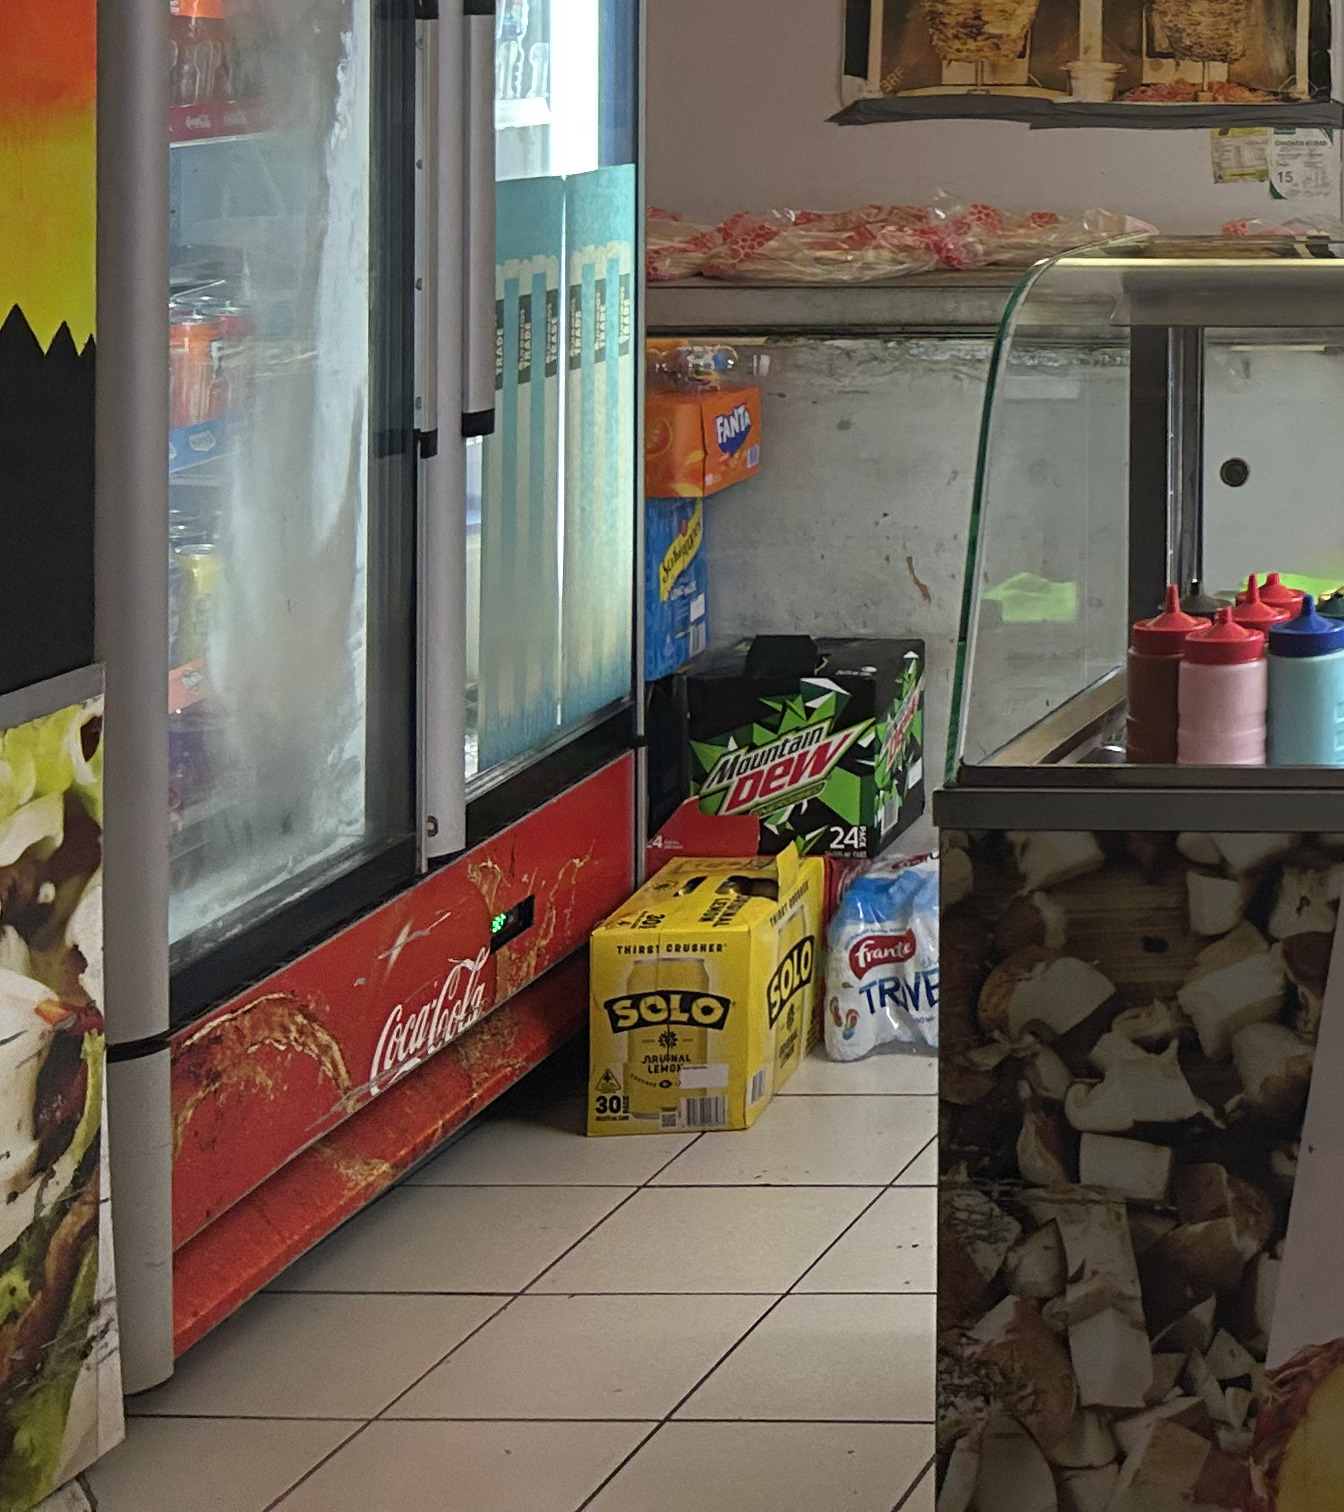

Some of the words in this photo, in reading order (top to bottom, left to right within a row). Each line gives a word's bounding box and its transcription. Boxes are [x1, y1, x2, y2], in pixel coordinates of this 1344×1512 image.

[715, 404, 751, 444] FANTA
[705, 725, 825, 792] Mountain
[829, 825, 859, 849] 24
[666, 943, 723, 954] CRUSHER
[769, 940, 812, 1019] SOLO
[369, 946, 491, 1097] Coca-Cola
[611, 994, 725, 1029] SOLO
[596, 1095, 621, 1114] 30
